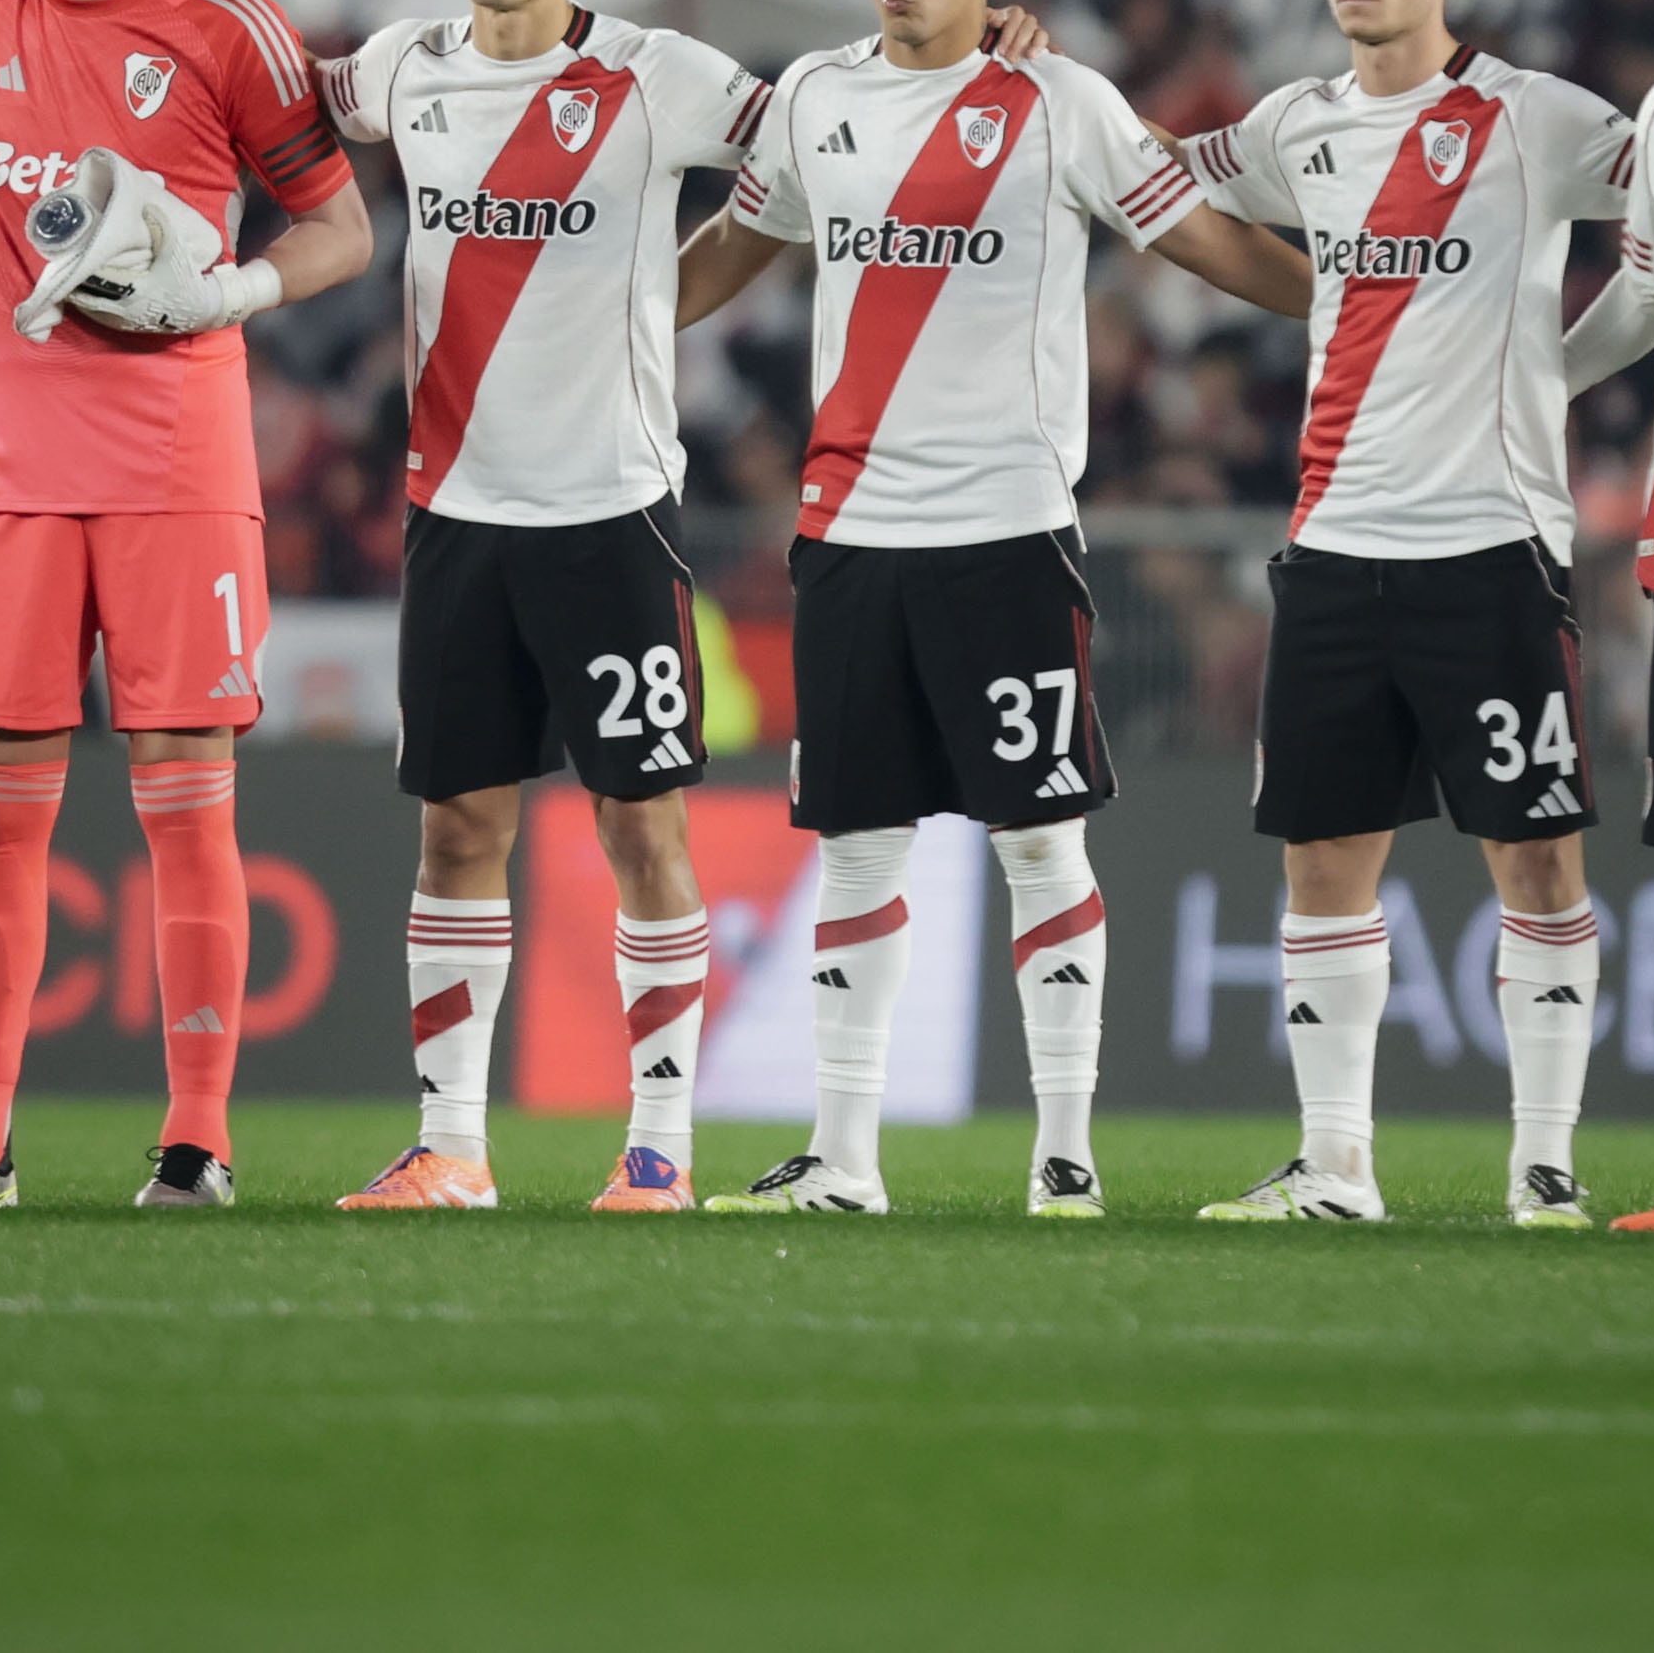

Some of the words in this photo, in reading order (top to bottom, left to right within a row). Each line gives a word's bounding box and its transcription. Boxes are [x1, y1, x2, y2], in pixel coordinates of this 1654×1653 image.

[419, 187, 597, 238] Betano
[827, 216, 1004, 265] Betano
[1315, 228, 1471, 279] Betano
[213, 571, 241, 657] 1
[586, 644, 689, 739] 28
[985, 667, 1078, 762] 37
[1475, 691, 1579, 783] 34
